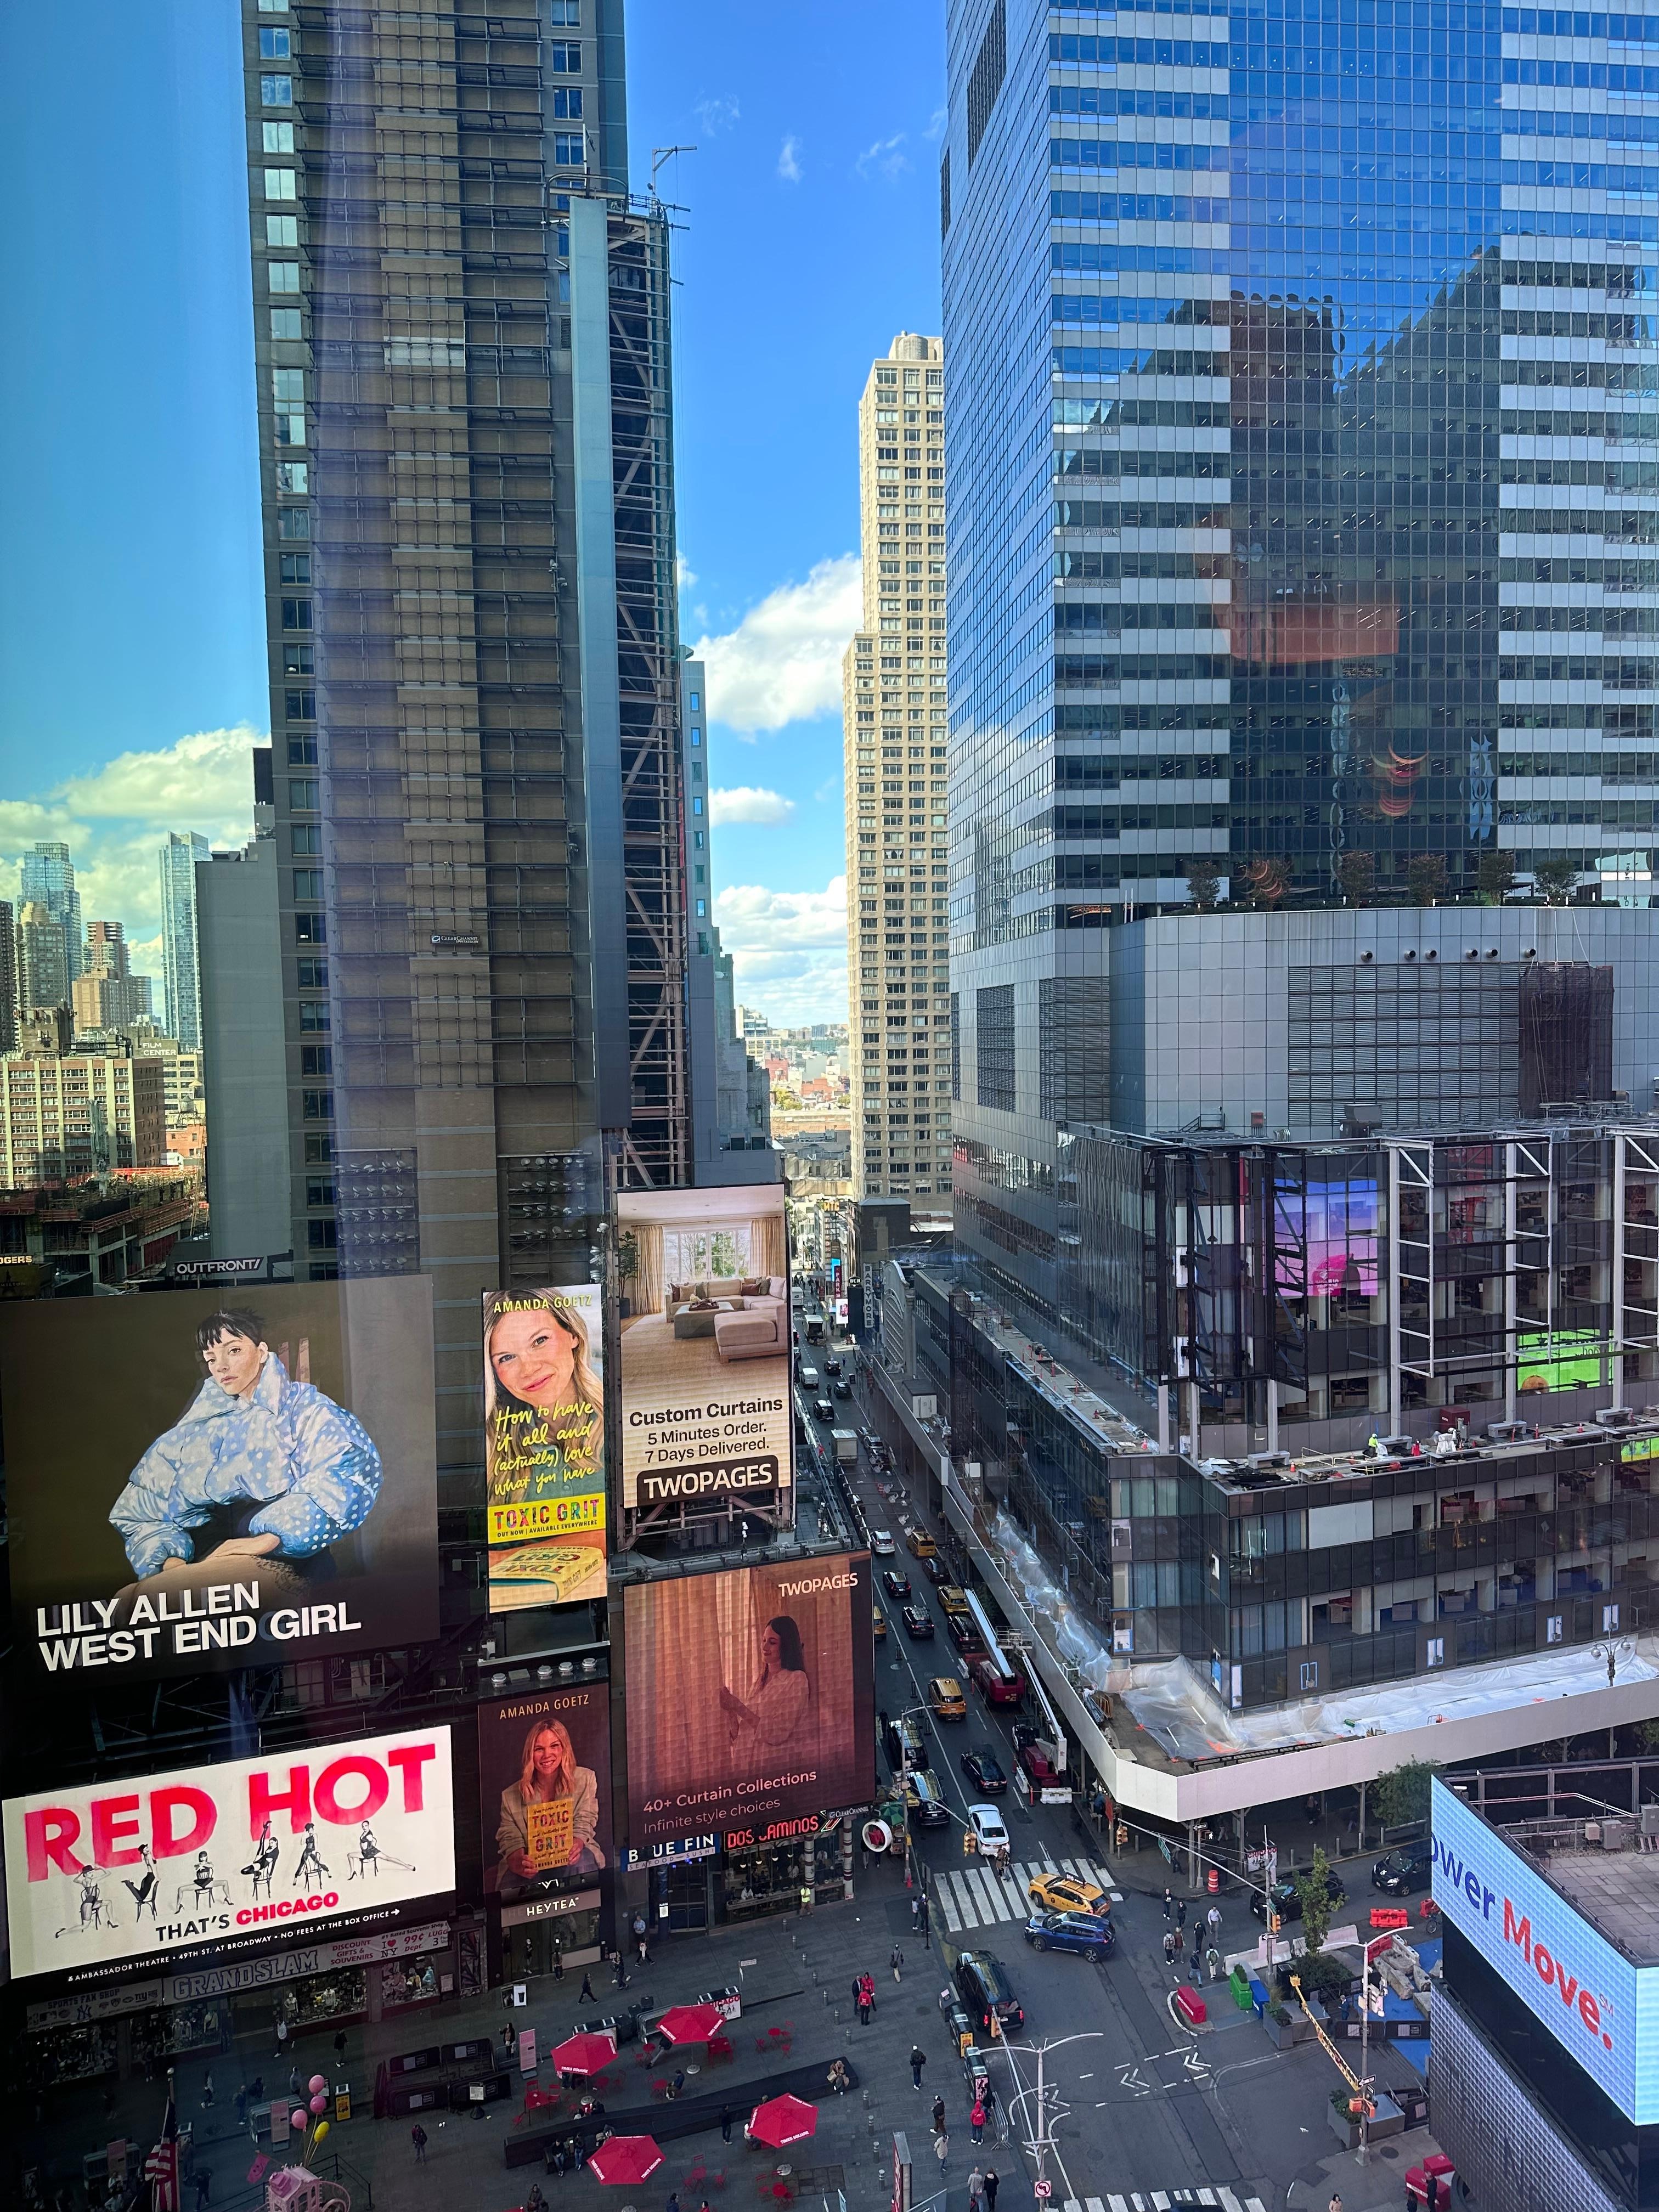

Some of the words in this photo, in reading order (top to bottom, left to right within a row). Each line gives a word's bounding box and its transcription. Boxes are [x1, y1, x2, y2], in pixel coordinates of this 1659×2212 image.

[494, 1299, 549, 1313] AMANDA
[554, 1295, 592, 1308] GOETZ
[865, 1265, 873, 1327] BARRYMORE
[495, 1406, 533, 1432] How
[538, 1404, 549, 1418] to
[552, 1400, 594, 1420] have
[630, 1407, 702, 1426] Custom
[707, 1398, 783, 1418] Curtains
[497, 1433, 512, 1452] it
[522, 1423, 549, 1447] all
[556, 1420, 593, 1440] and
[647, 1433, 657, 1445] 5
[661, 1427, 720, 1444] Minutes
[724, 1421, 767, 1436] Order.
[494, 1447, 558, 1476] (actually)
[564, 1446, 593, 1463] love
[645, 1451, 654, 1463] 7
[658, 1448, 695, 1462] Days
[699, 1437, 769, 1457] Delivered.
[495, 1476, 531, 1496] what
[535, 1470, 556, 1493] you
[563, 1467, 595, 1482] have
[644, 1463, 772, 1499] TWOPAGES
[494, 1505, 550, 1530] TOXIC
[557, 1499, 599, 1522] GRIT
[529, 1525, 560, 1534] AVAILABLE
[561, 1520, 597, 1530] EVERYWHERE
[778, 1572, 859, 1598] TWOPAGES
[37, 1598, 119, 1637] LILY
[128, 1581, 259, 1625] ALLEN
[38, 1627, 161, 1671] WEST
[175, 1615, 257, 1654] END
[270, 1602, 362, 1640] GIRL
[500, 1702, 550, 1720] AMANDA
[554, 1694, 589, 1709] GOETZ
[643, 1799, 672, 1813] 40+
[676, 1786, 732, 1807] Curtain
[736, 1770, 817, 1795] Collections
[25, 1786, 218, 1883] RED
[249, 1743, 436, 1842] HOT
[532, 1810, 569, 1829] TOXIC
[644, 1816, 692, 1834] Infinite
[696, 1808, 726, 1824] style
[730, 1799, 780, 1817] choices
[536, 1833, 566, 1852] GRIT
[629, 1841, 675, 1863] BUE
[685, 1833, 714, 1851] FIN
[728, 1829, 754, 1848] DOS
[629, 1857, 674, 1870] SEAFOOD
[686, 1848, 714, 1859] SUSHI
[155, 1914, 230, 1942] THAT'S
[236, 1892, 339, 1925] CHICAGO
[527, 1897, 576, 1916] HEYTEA
[404, 1933, 424, 1944] 99¢
[406, 1926, 430, 1934] Souvenir
[433, 1938, 438, 1946] 3
[75, 1964, 133, 1981] AMBASSADOR
[135, 1956, 169, 1970] THEATRE
[179, 1950, 198, 1960] 49TH
[228, 1935, 272, 1950] BROADWAY
[281, 1931, 293, 1939] NO
[296, 1927, 314, 1936] FEES
[328, 1920, 342, 1928] THE
[345, 1916, 360, 1926] BOX
[363, 1911, 389, 1922] OFFICE
[332, 1940, 371, 1951] DISCOUNT
[337, 1949, 357, 1957] GIFTS
[381, 1948, 399, 1958] NY
[330, 1953, 374, 1965] SOUVENIRS
[173, 1966, 252, 1999] GRAND
[255, 1950, 319, 1978] SLAM
[1504, 1896, 1612, 2051] Move.
[48, 1997, 78, 2009] SPORTS
[81, 1993, 97, 2003] FAN
[99, 1988, 121, 1999] SHOP
